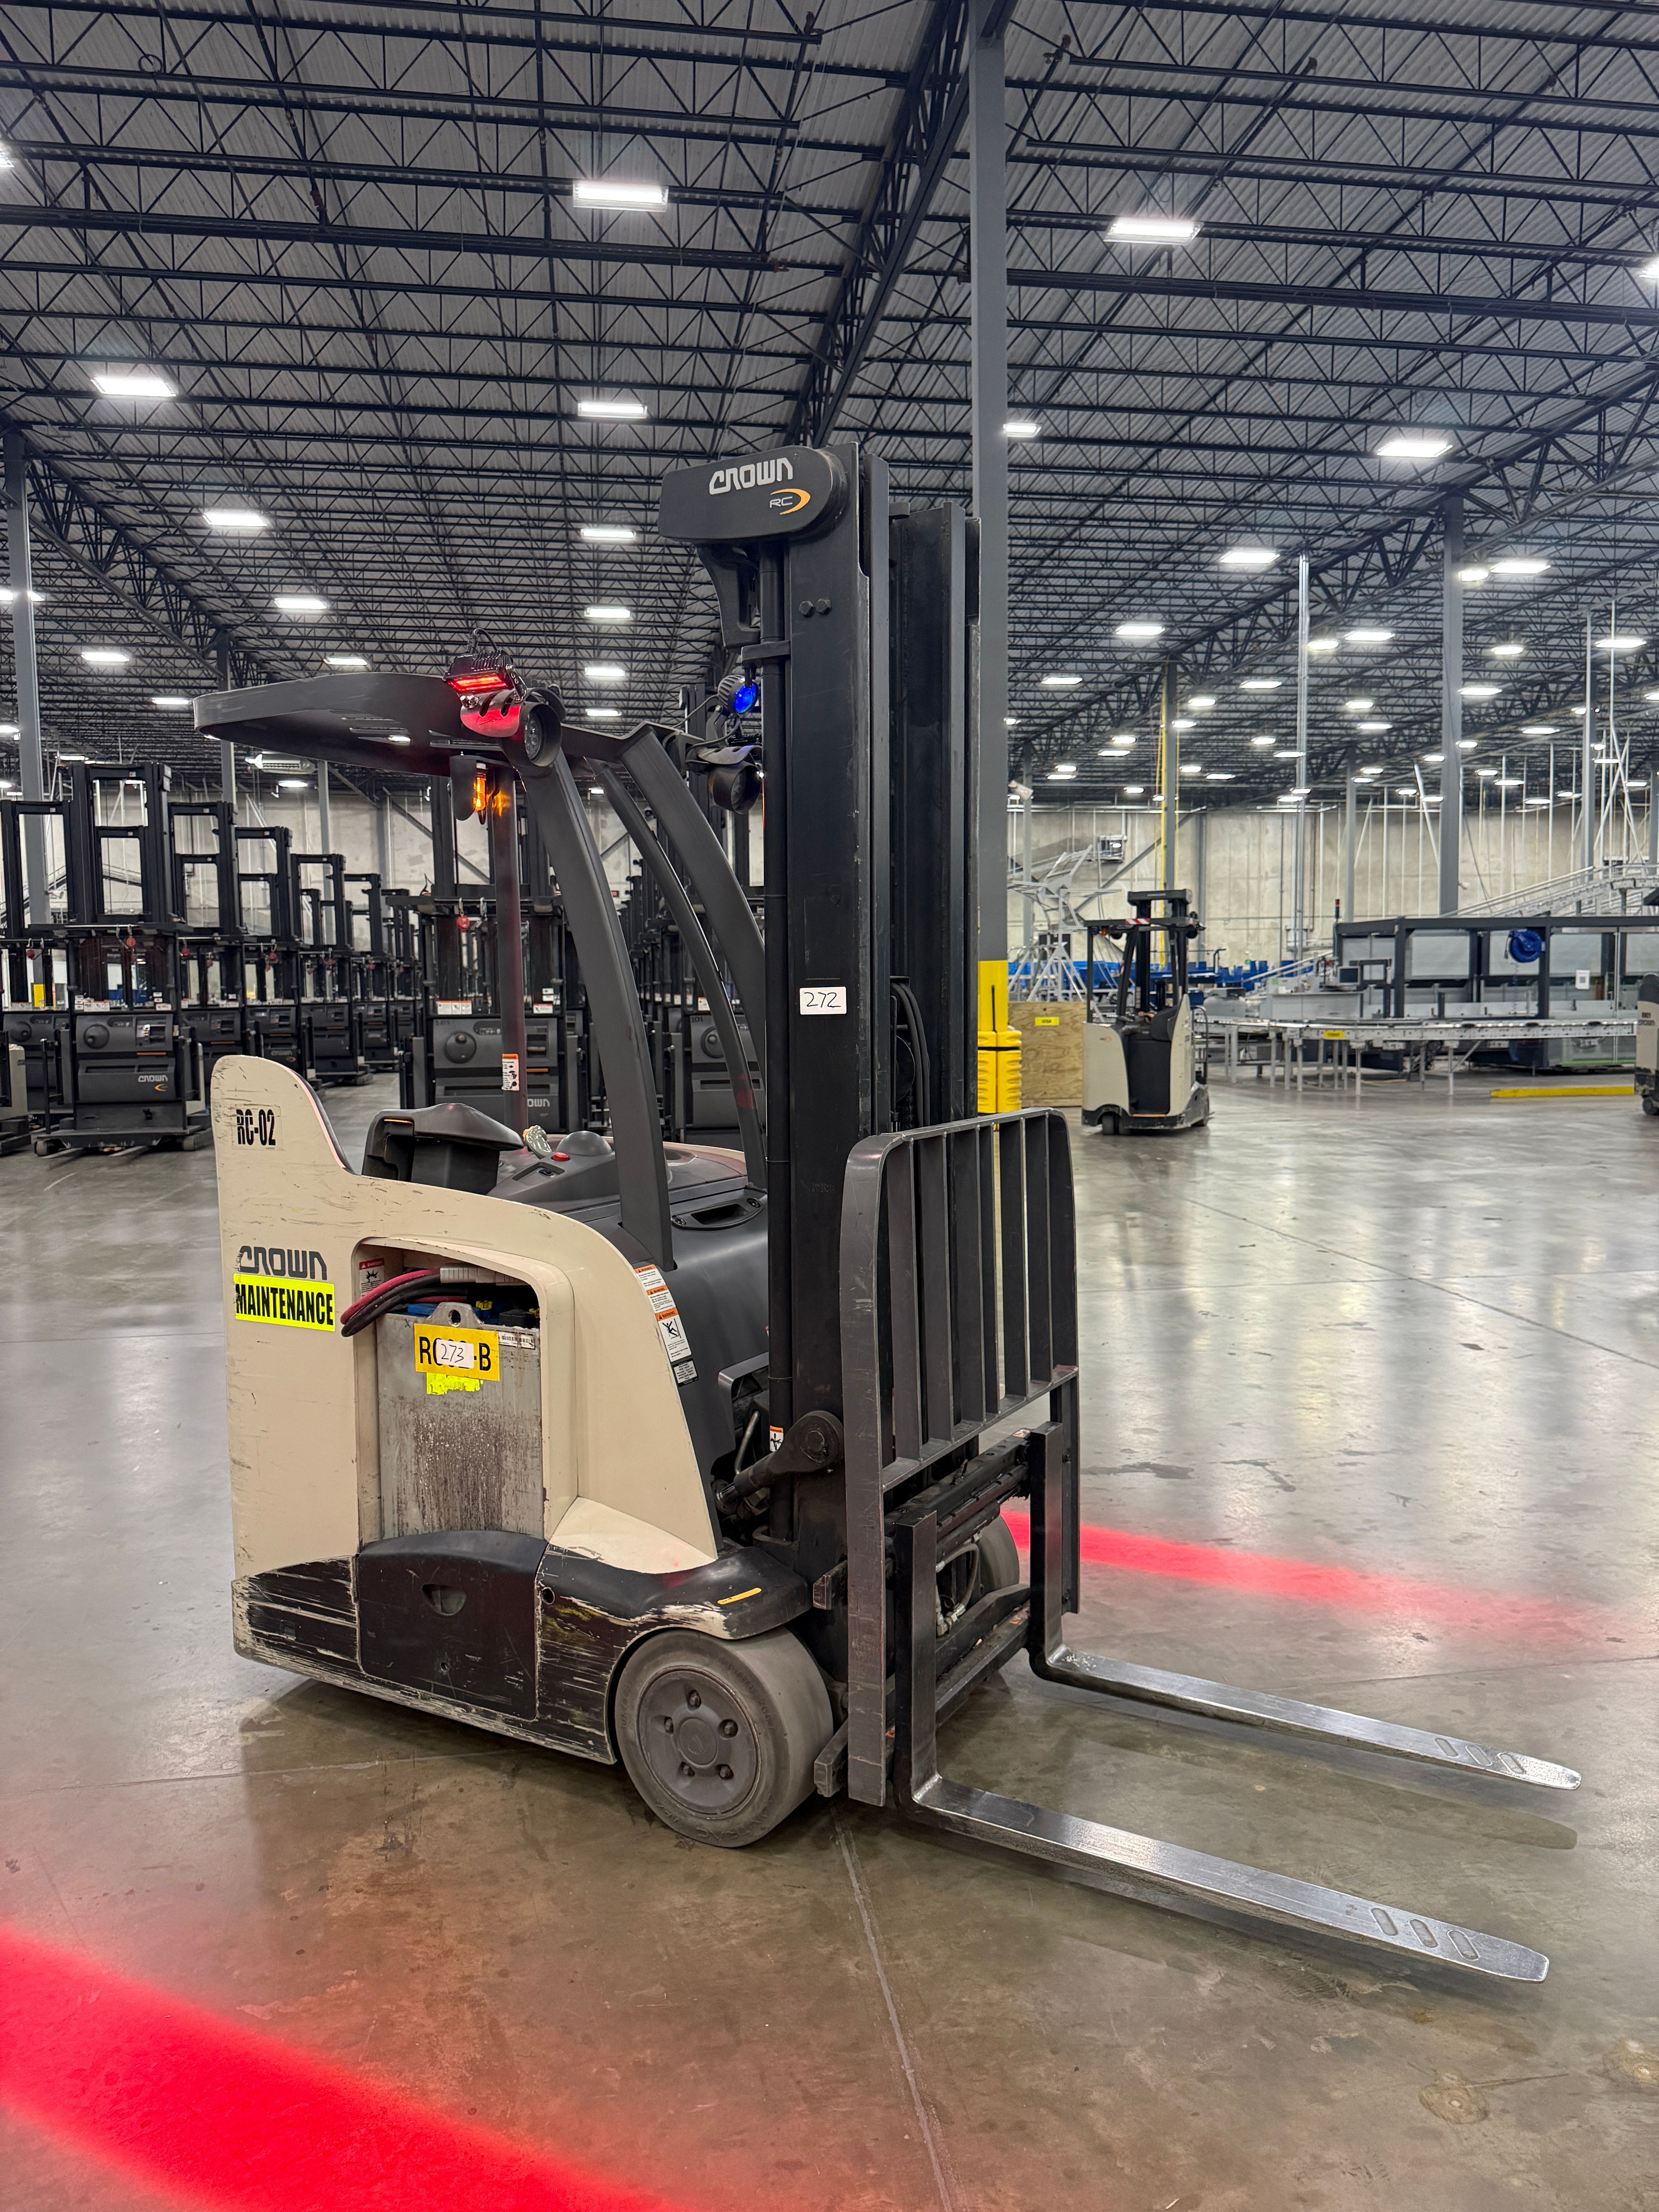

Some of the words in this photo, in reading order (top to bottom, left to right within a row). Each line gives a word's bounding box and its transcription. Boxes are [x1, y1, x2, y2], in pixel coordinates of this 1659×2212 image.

[709, 457, 793, 495] CROWN
[769, 496, 793, 509] RC
[804, 992, 842, 1008] 272
[137, 1074, 168, 1083] CROWN
[527, 1098, 550, 1107] OWN
[236, 1109, 276, 1146] RC-02
[238, 1245, 327, 1281] CROWN
[235, 1283, 334, 1325] MAINTENANCE
[441, 1343, 464, 1363] 273
